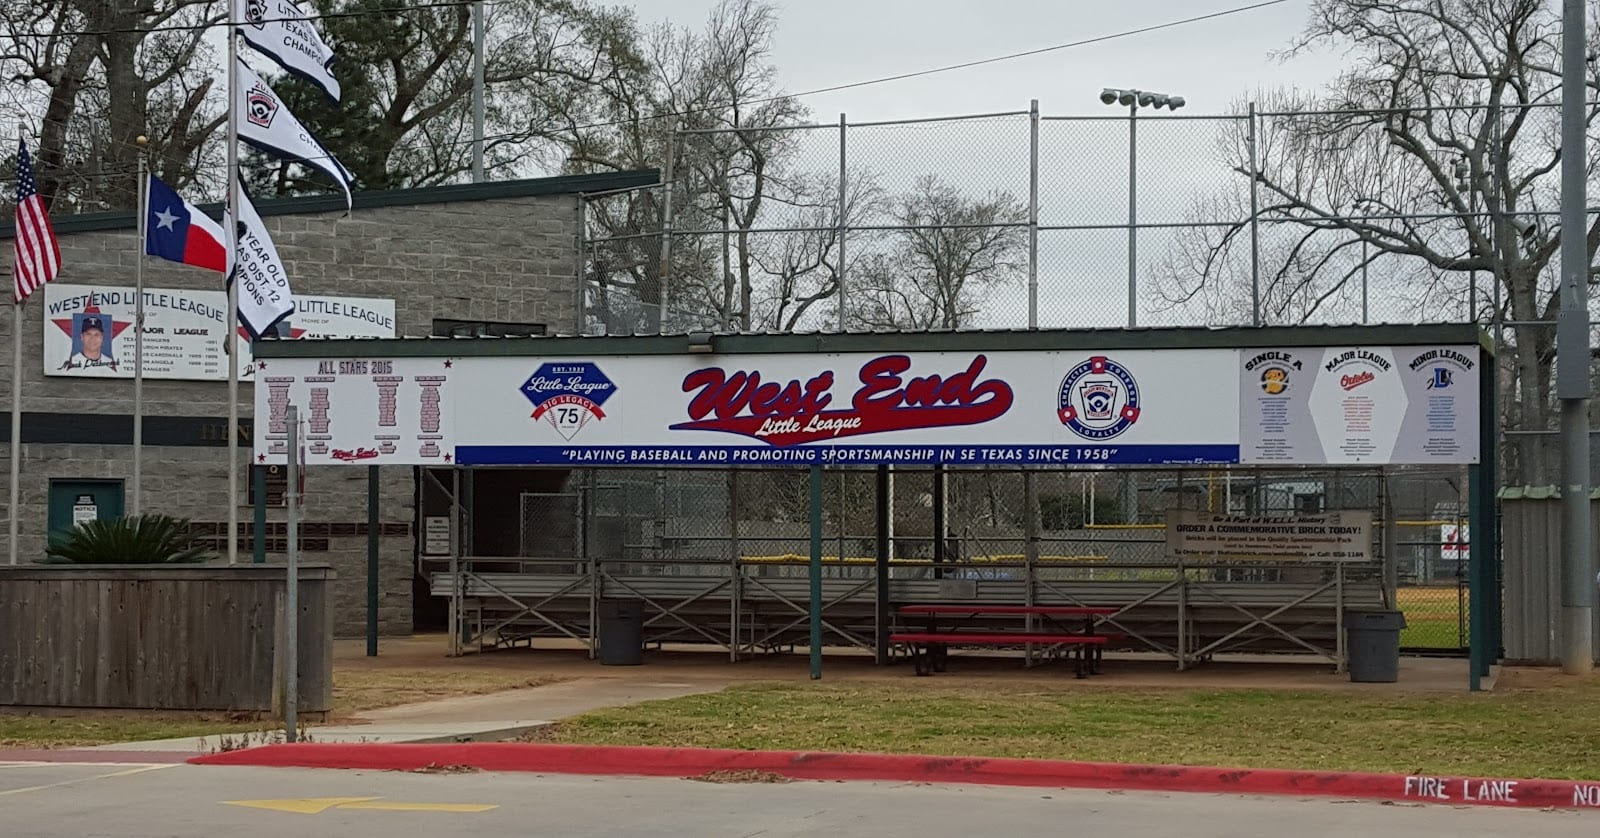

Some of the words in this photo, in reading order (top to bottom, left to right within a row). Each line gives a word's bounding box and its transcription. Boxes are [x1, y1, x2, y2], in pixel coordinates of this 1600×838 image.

[246, 232, 270, 264] YEAR
[267, 264, 286, 287] OLD
[267, 290, 281, 303] 12
[49, 295, 88, 314] WEST
[91, 292, 121, 305] END
[124, 292, 168, 307] LITLE
[171, 295, 224, 323] LEAGUE
[299, 300, 340, 315] LITTLE
[343, 305, 393, 330] LEAGUE
[318, 361, 336, 375] ALL
[339, 361, 368, 375] STARS
[371, 361, 393, 374] 2015
[1245, 351, 1292, 371] SINGLE
[1292, 360, 1303, 371] A
[1325, 351, 1355, 372] MAJOR
[1358, 350, 1391, 371] LEAGUE
[1409, 350, 1437, 370] MINOR
[1440, 349, 1475, 370] LEAGUE
[527, 376, 564, 392] Little
[564, 376, 610, 394] League
[682, 367, 834, 420] West
[852, 354, 987, 412] End
[1062, 365, 1089, 405] CHARACTER
[1109, 365, 1137, 402] COURAGE
[542, 397, 558, 410] BIG
[560, 396, 595, 410] LEGACY
[557, 408, 578, 424] 75
[755, 414, 801, 436] Little
[803, 414, 862, 436] League
[1079, 427, 1120, 437] LOYALTY
[630, 450, 693, 461] BASEBALL
[698, 450, 728, 461] AND
[732, 450, 816, 461] PROMOTING
[820, 449, 935, 461] SPORTSMANSHIP
[940, 449, 956, 461] IN
[960, 449, 976, 460] SE
[981, 449, 1023, 460] TEXAS
[1028, 449, 1070, 461] SINCE
[1176, 524, 1206, 532] ORDER
[1216, 525, 1296, 534] COMMEMORATIVE
[1298, 526, 1326, 534] BRICK
[1328, 526, 1361, 534] TODAY!
[1405, 777, 1450, 799] FIRE
[1463, 779, 1519, 803] LANE
[1573, 784, 1600, 806] NO
